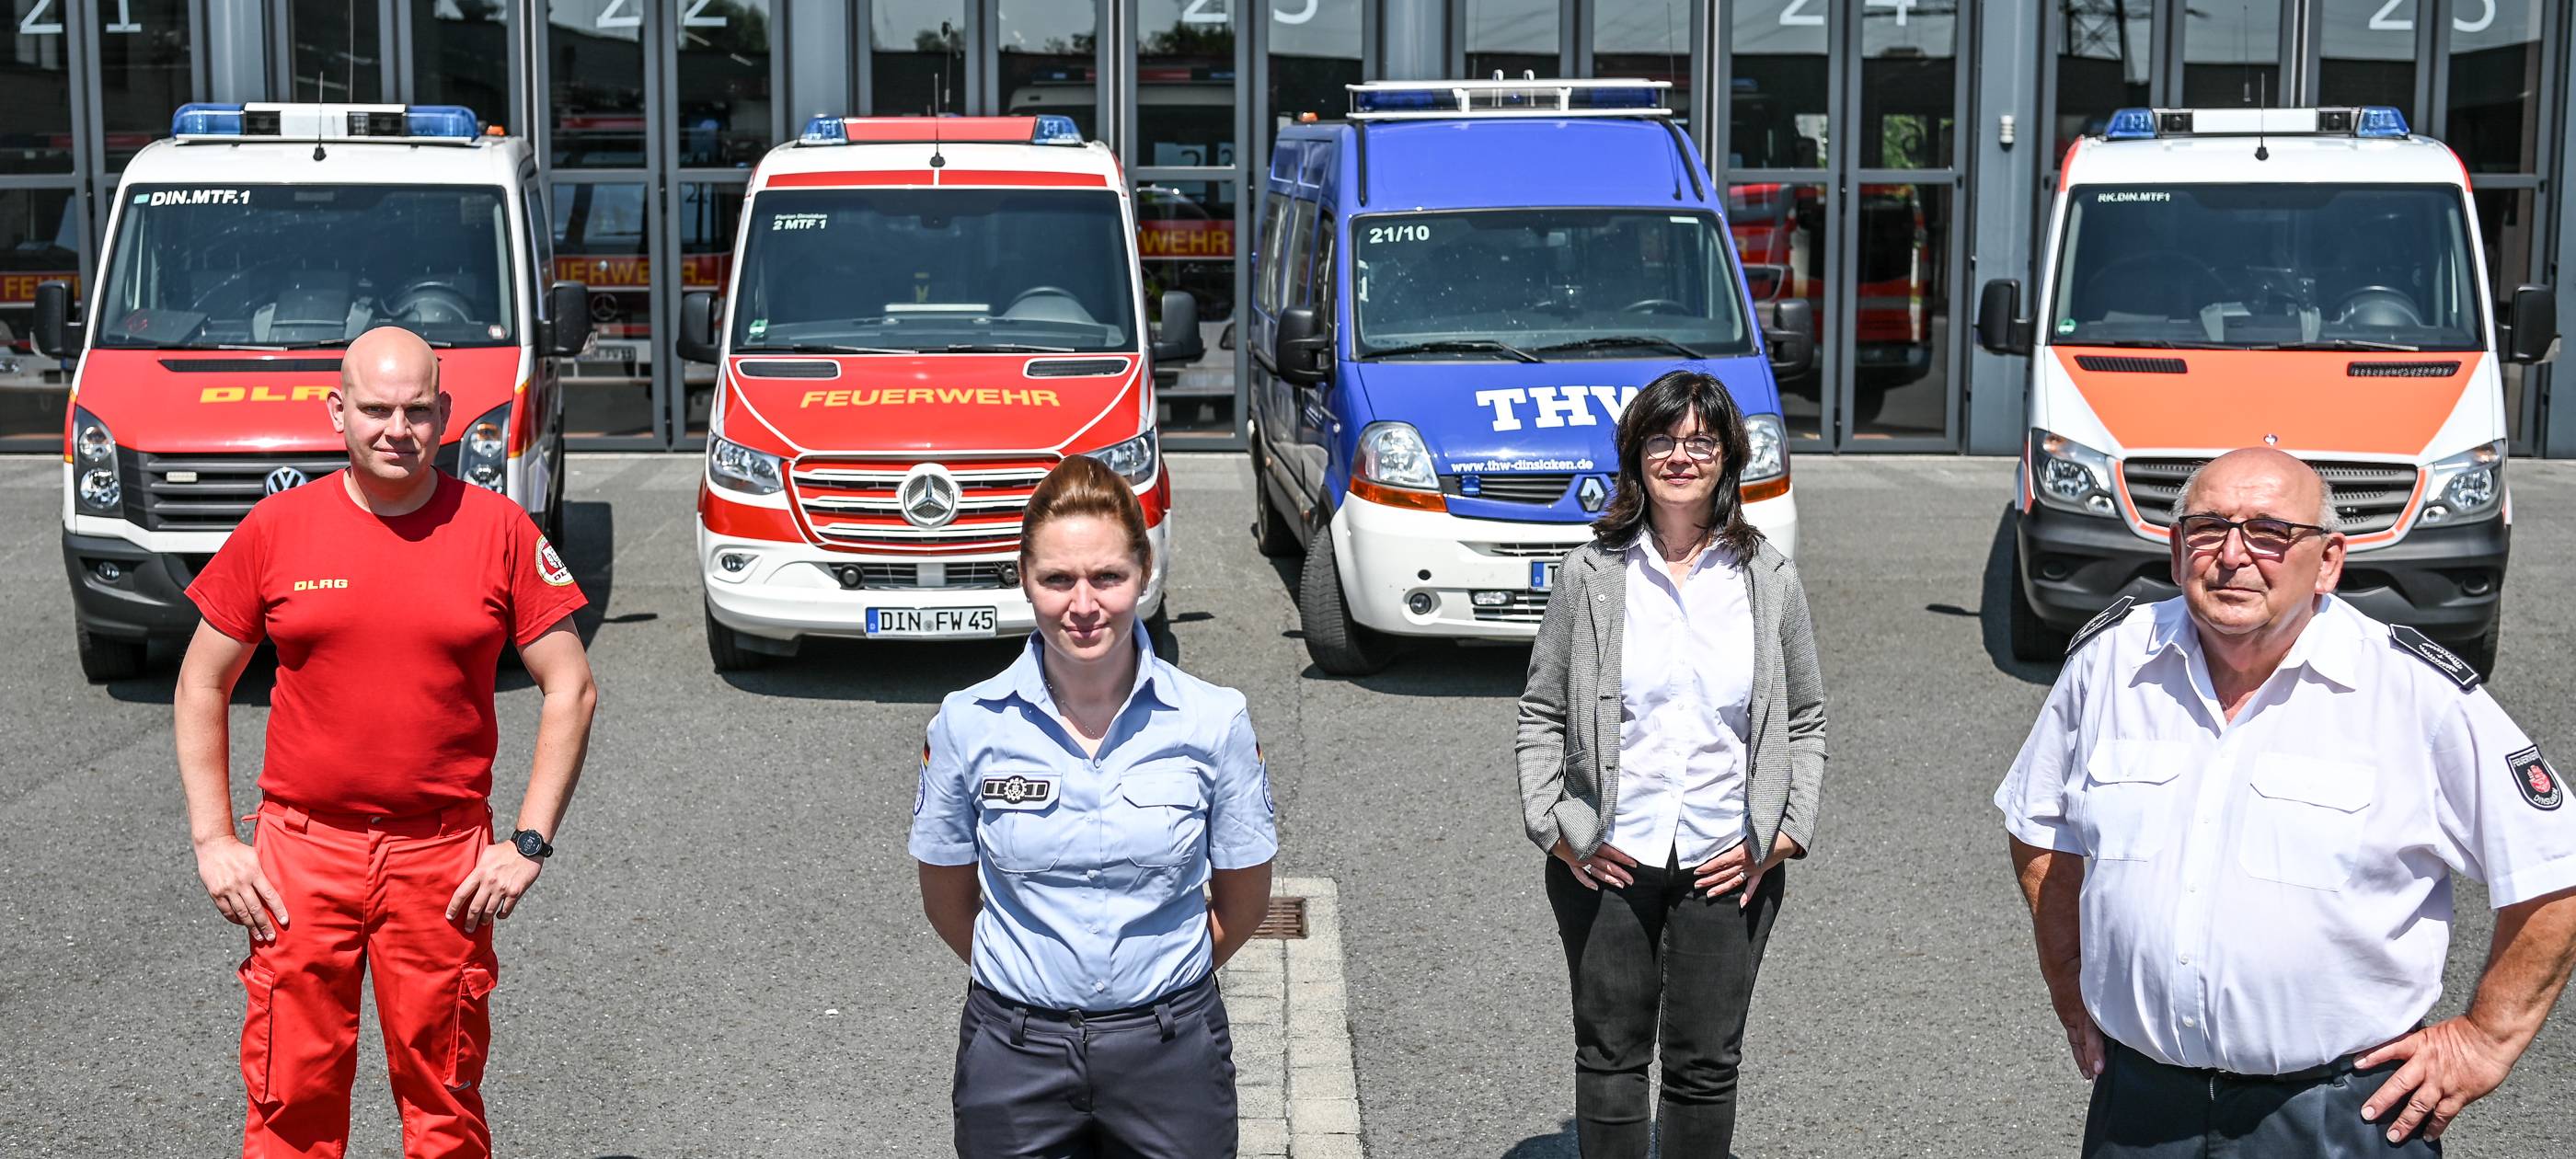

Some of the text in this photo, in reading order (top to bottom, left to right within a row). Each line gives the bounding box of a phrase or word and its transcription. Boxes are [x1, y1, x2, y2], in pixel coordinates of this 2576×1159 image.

[150, 189, 251, 207] DIN.MTF.1
[2098, 192, 2171, 202] RK.DIN.MTF1
[773, 220, 826, 230] 2 MTF 1
[1369, 225, 1431, 244] 21/10
[560, 260, 697, 285] ERWER
[200, 385, 330, 404] DLR
[799, 388, 1061, 408] FEUERWEHR
[1450, 459, 1594, 473] www.thw-dinslaken.de
[293, 579, 349, 591] DLRG
[880, 611, 922, 631] DIN
[936, 611, 963, 631] FW
[968, 610, 994, 630] 45
